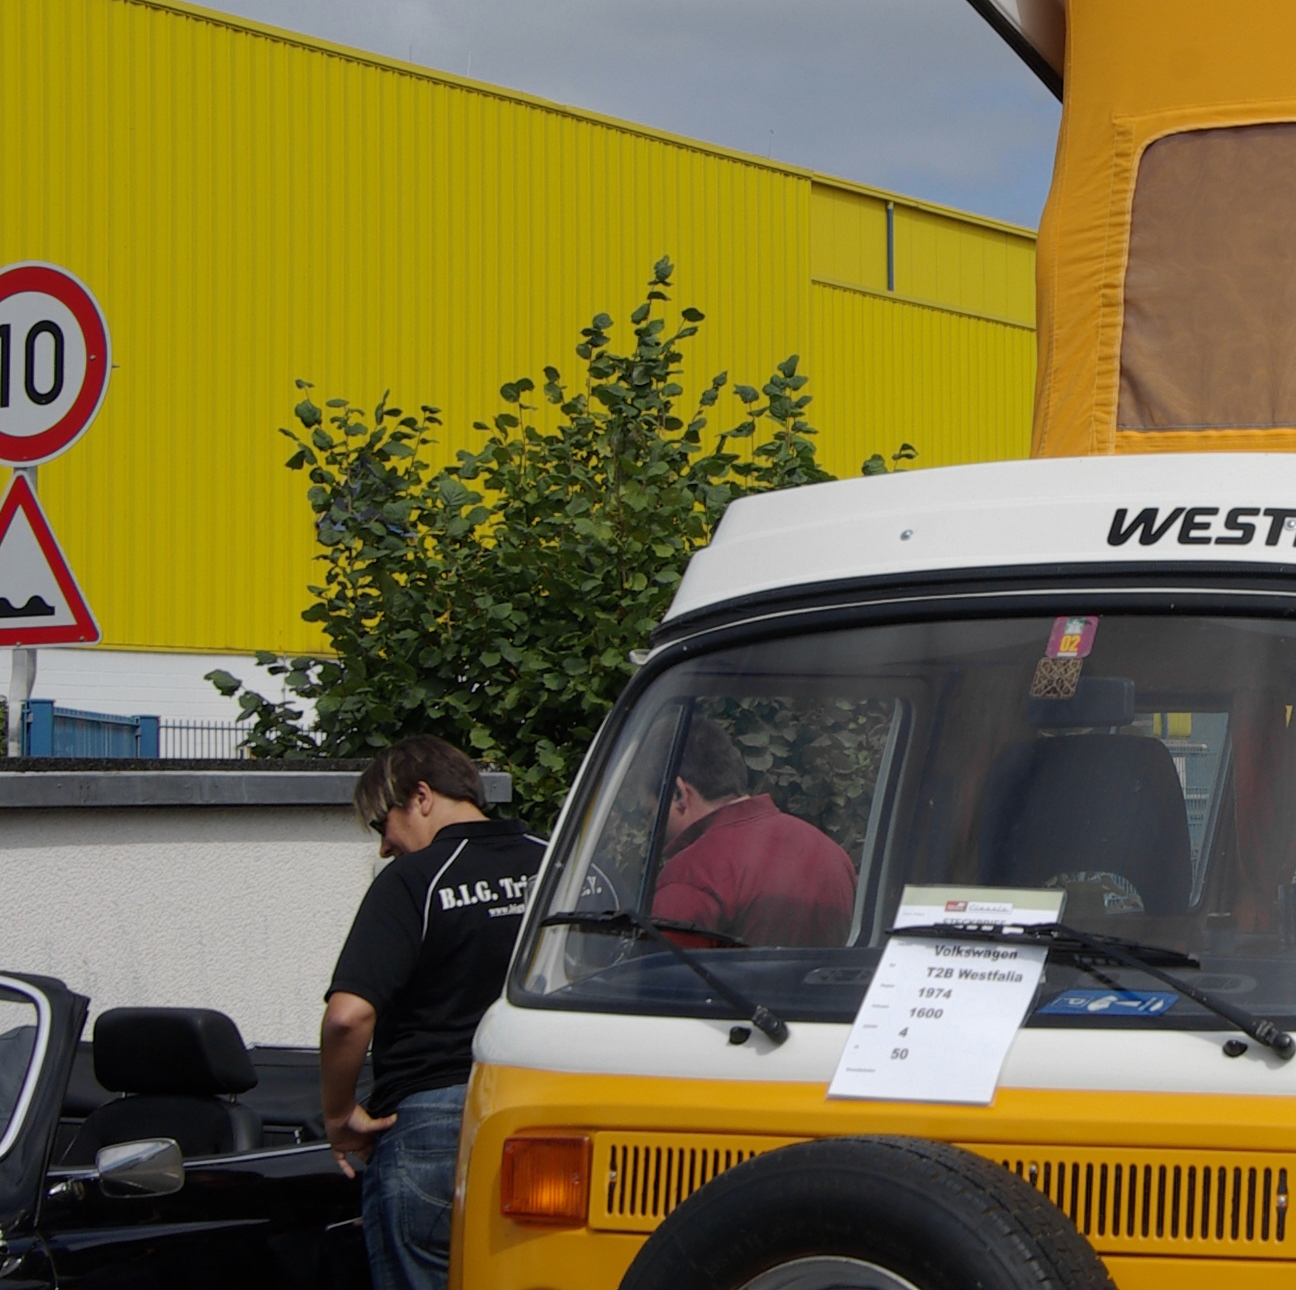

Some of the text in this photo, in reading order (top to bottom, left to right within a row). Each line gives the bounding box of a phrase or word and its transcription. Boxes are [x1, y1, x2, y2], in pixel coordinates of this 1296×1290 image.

[0, 320, 65, 407] 10
[1059, 634, 1082, 652] 02
[438, 880, 499, 911] B.I.G.
[934, 944, 1018, 962] Volkswagen
[926, 966, 1024, 983] T2B Westfalia
[918, 987, 953, 1000] 1974
[909, 1007, 944, 1020] 1600
[898, 1026, 909, 1038] 4
[890, 1047, 909, 1060] 50
